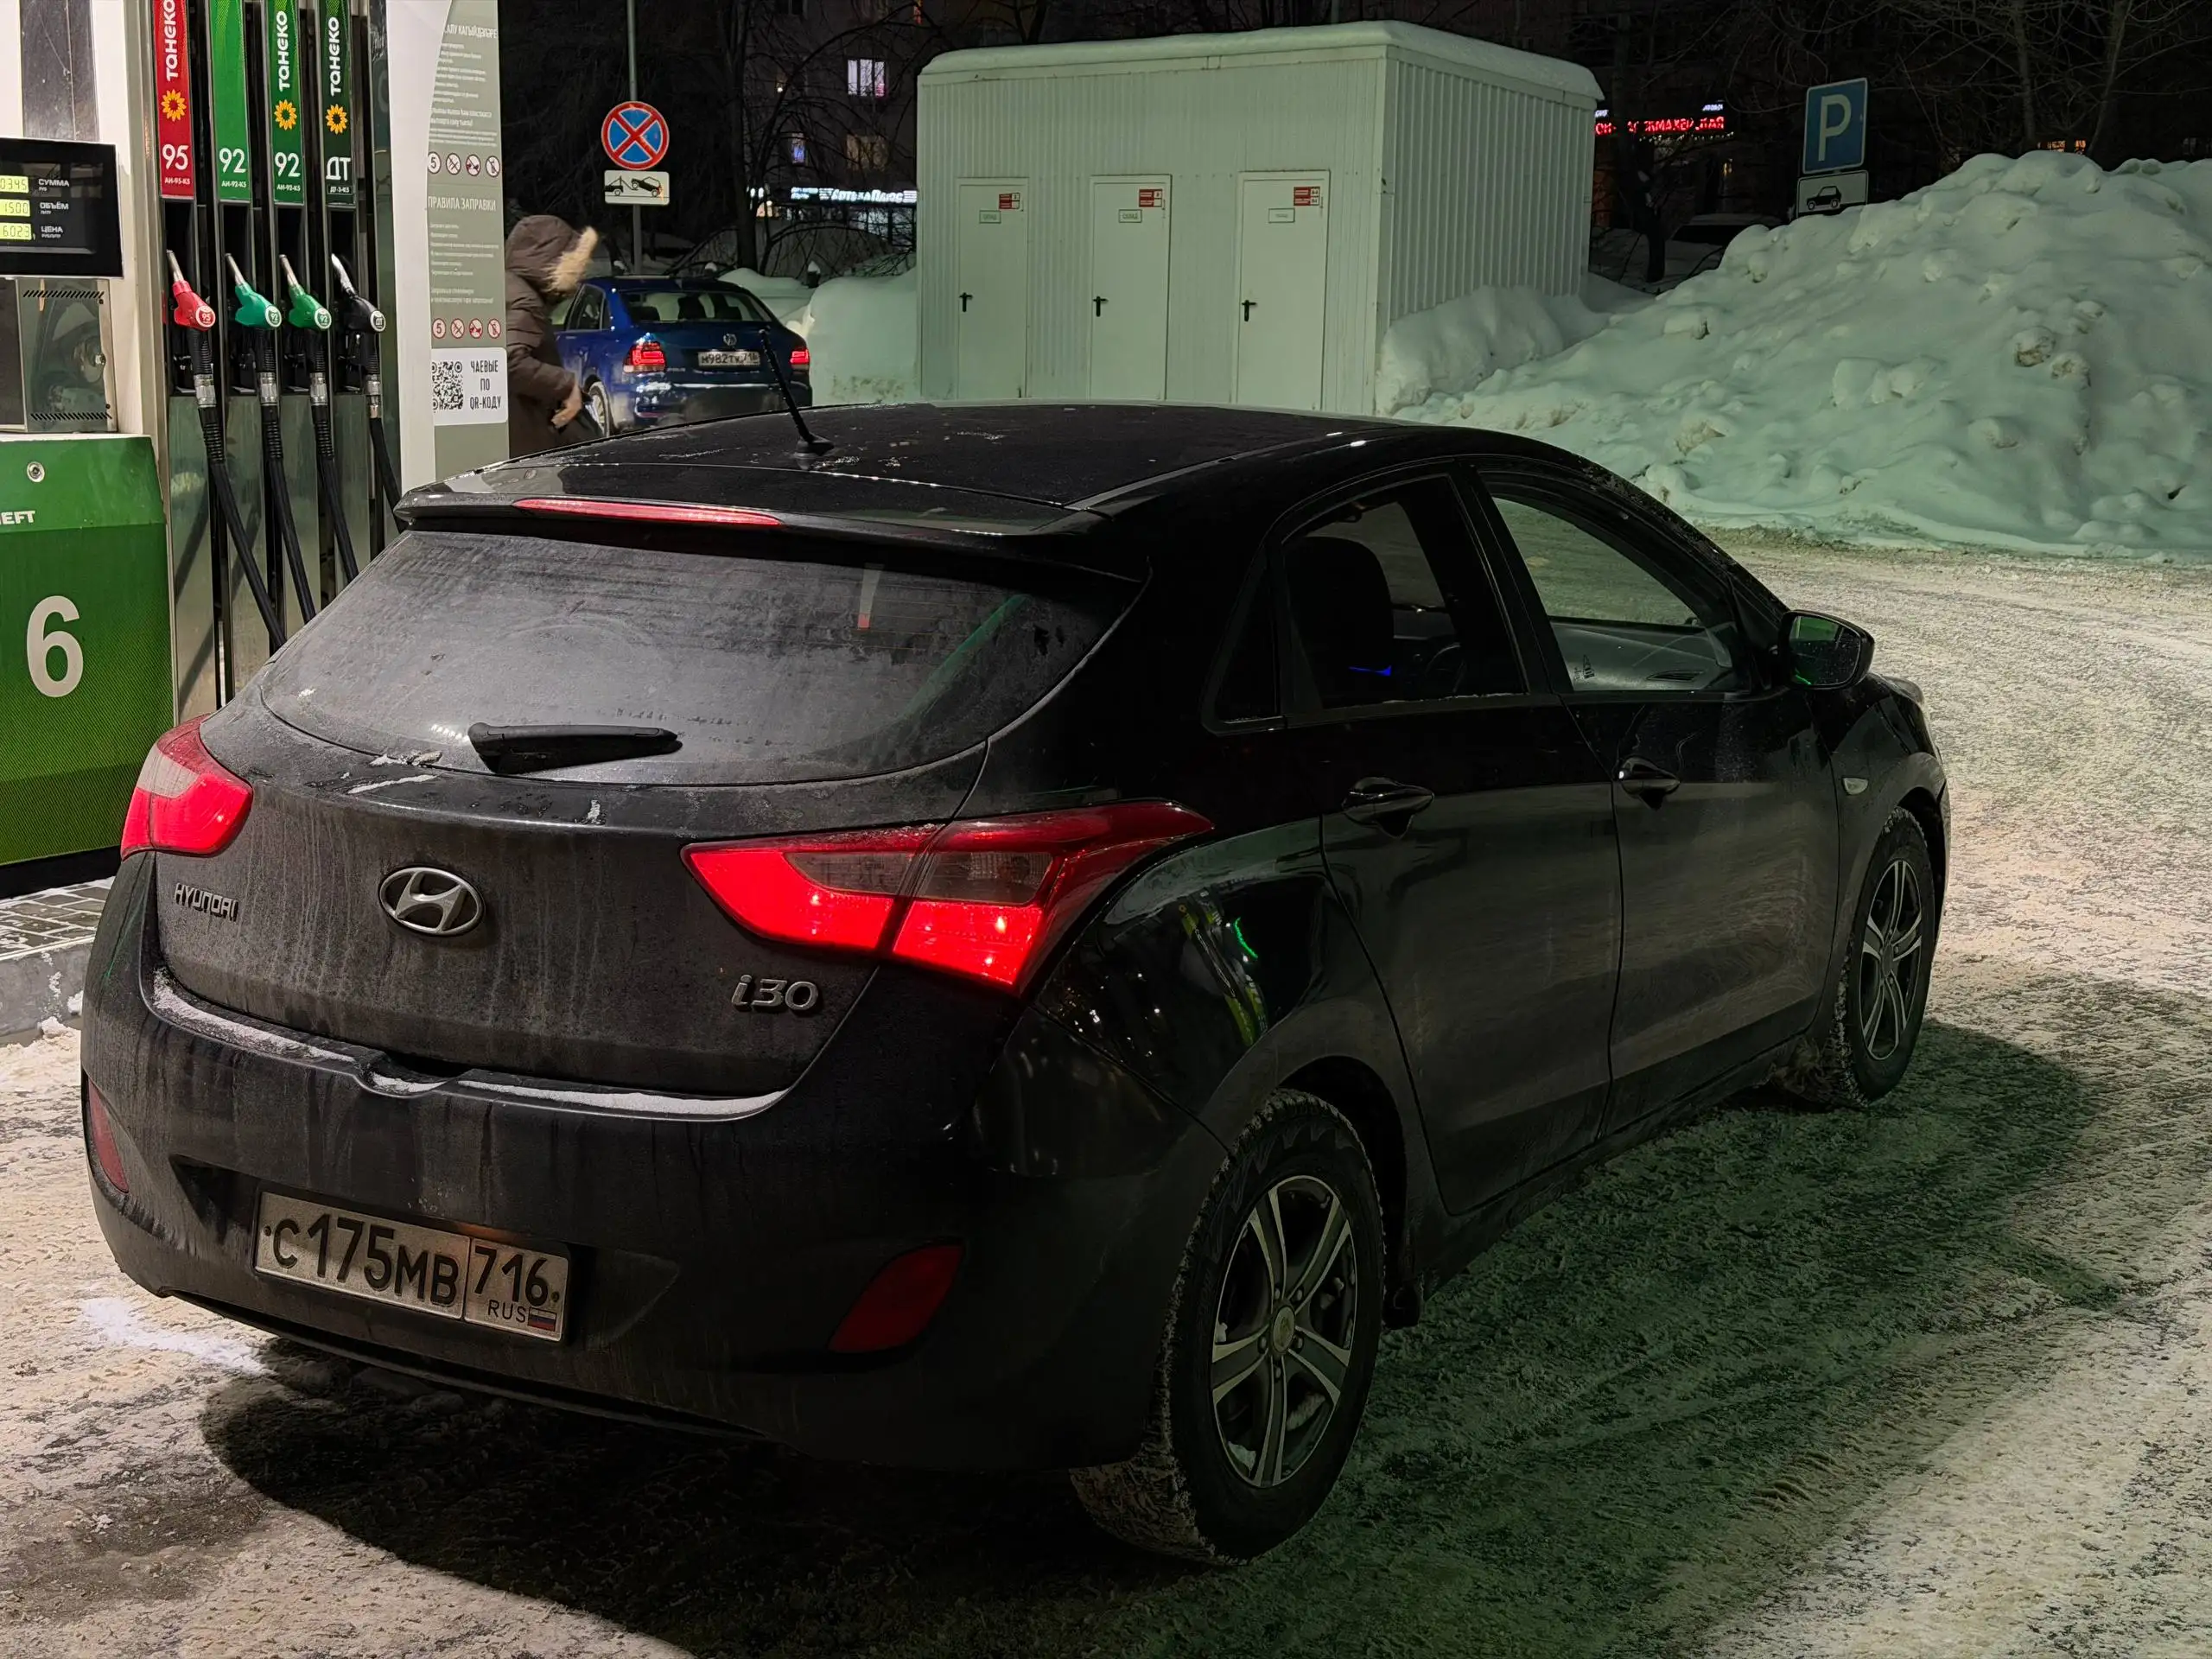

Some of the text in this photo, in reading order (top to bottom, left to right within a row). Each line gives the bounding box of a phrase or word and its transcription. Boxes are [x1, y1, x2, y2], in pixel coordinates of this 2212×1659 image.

[1818, 94, 1852, 162] P
[162, 143, 189, 171] 95
[219, 148, 246, 174] 92
[275, 152, 301, 178] 92
[430, 156, 437, 169] 5
[326, 156, 352, 181] ДТ
[38, 178, 70, 187] СУММА
[40, 201, 69, 210] ОБЪЁМ
[428, 195, 497, 211] ПРАВИЛА ЗАПРАВКИ
[201, 313, 211, 321] 95
[270, 313, 278, 321] 92
[436, 323, 442, 334] 5
[470, 359, 499, 373] ЧАЕВЫЕ
[480, 378, 490, 391] ПО
[469, 396, 502, 410] QR-КОДУ
[0, 511, 35, 524] EFT
[26, 595, 84, 697] 6
[175, 882, 238, 921] HYUNDAI
[731, 974, 819, 1011] i30
[474, 1245, 549, 1307] 716
[487, 1299, 527, 1324] RUS
